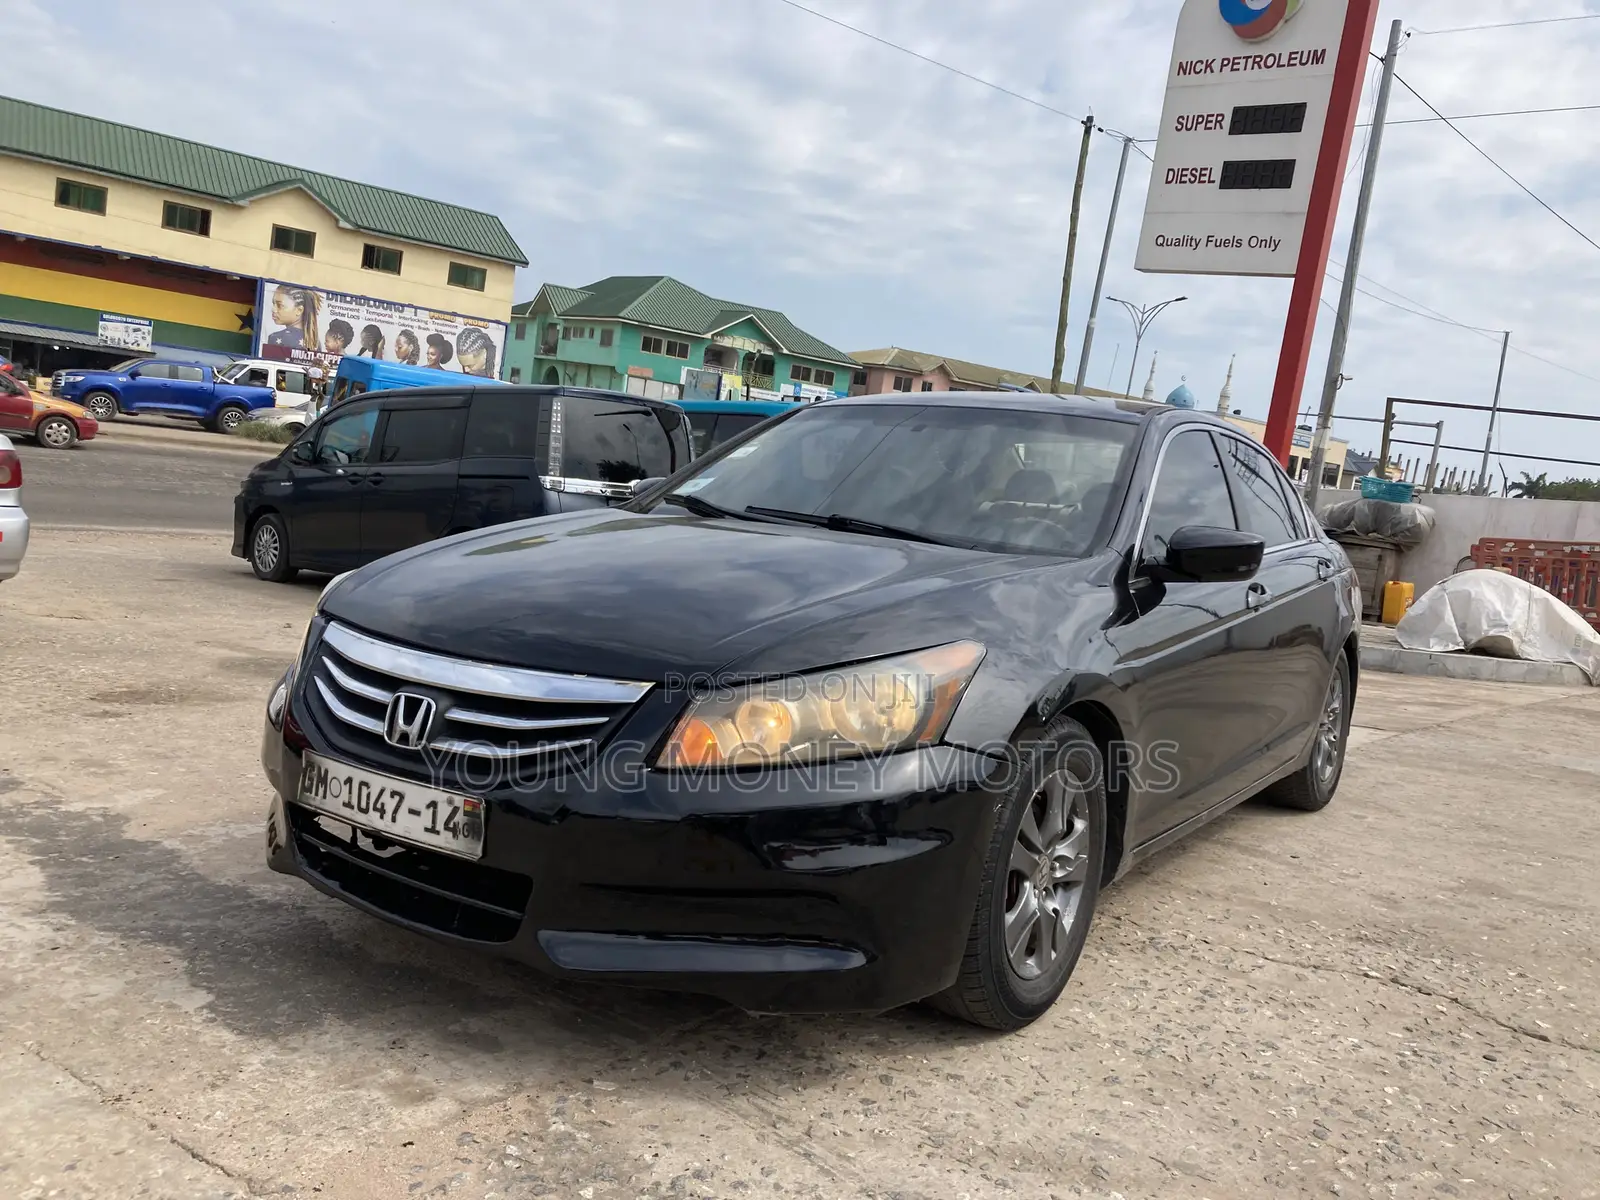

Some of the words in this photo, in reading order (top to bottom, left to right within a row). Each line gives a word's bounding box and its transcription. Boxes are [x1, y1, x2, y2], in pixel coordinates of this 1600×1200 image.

[1177, 58, 1216, 76] NICK
[1219, 48, 1326, 73] PETROLEUM
[1175, 113, 1225, 132] SUPER
[1165, 167, 1216, 184] DIESEL
[1155, 234, 1201, 251] Quality
[1205, 235, 1243, 249] Fuels
[1248, 235, 1281, 252] Only
[327, 303, 361, 314] Permanent
[365, 308, 394, 319] Temporal
[431, 320, 459, 330] Treatment
[329, 309, 347, 319] Sister
[347, 312, 361, 321] Locs
[463, 318, 490, 329] PROMO
[302, 762, 329, 800] GM
[341, 776, 461, 840] 1047-14
